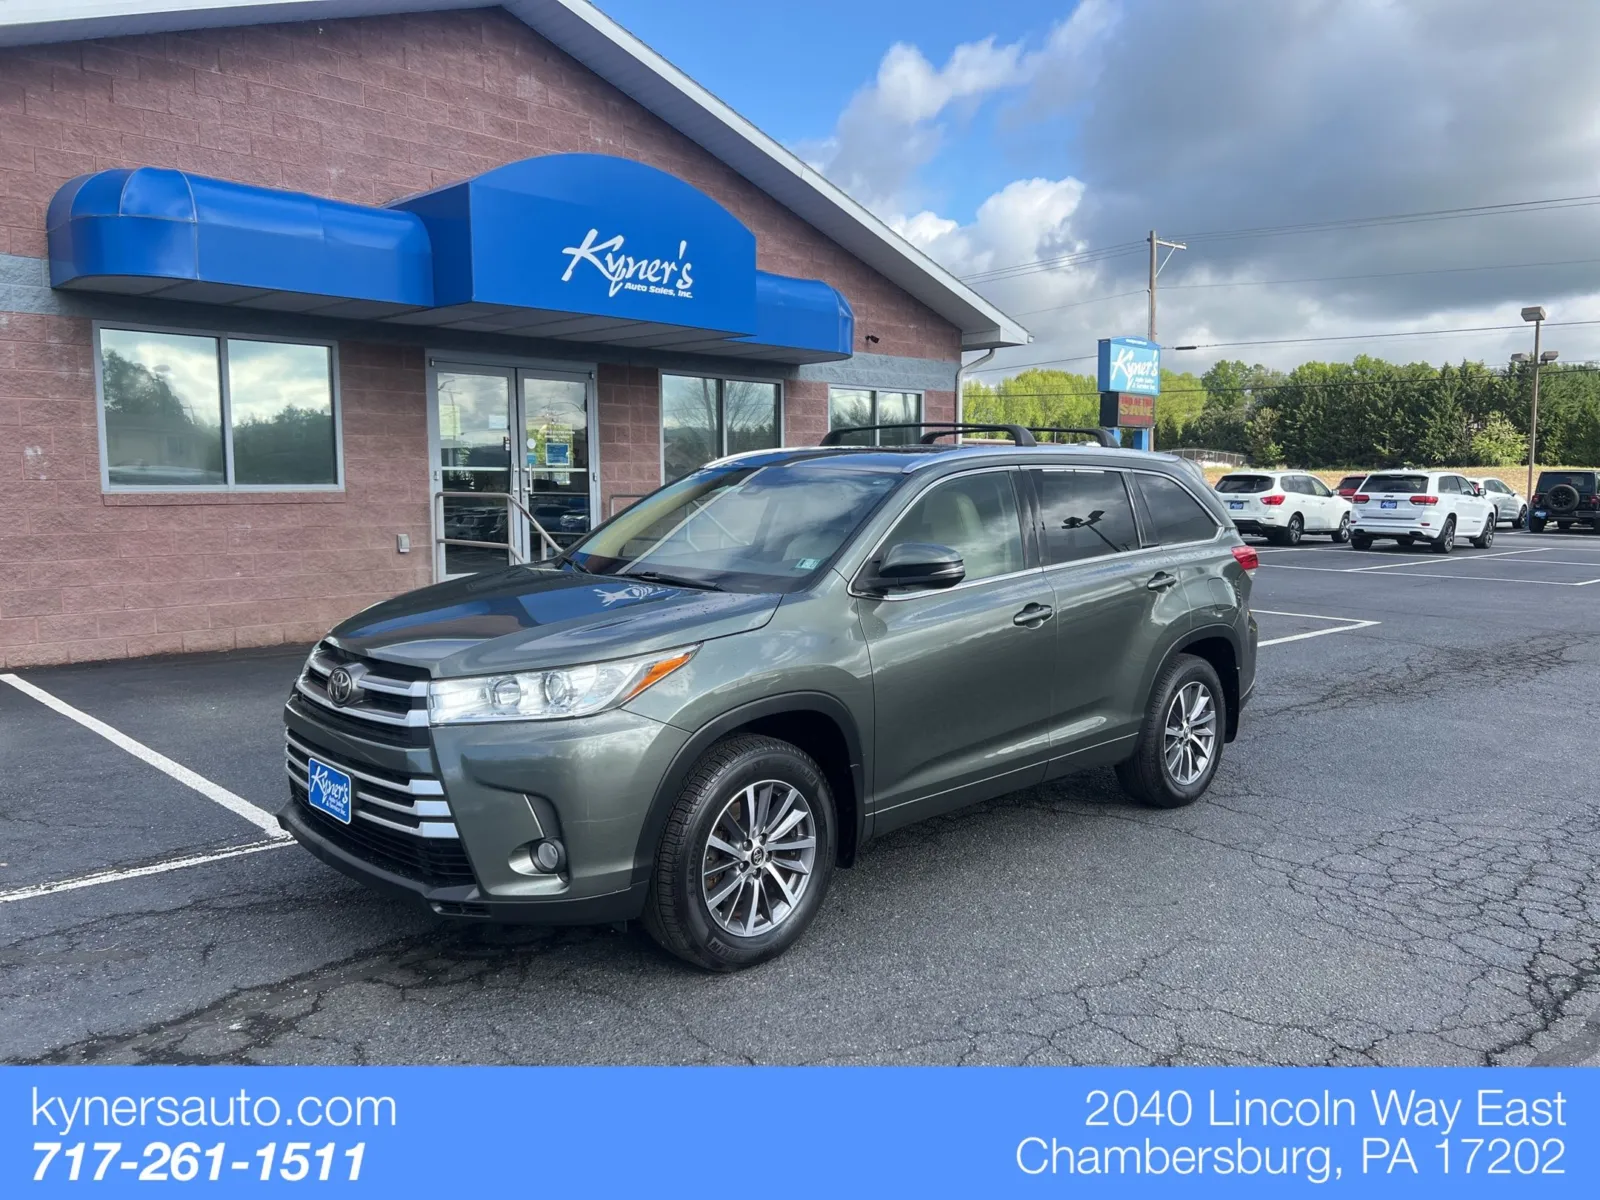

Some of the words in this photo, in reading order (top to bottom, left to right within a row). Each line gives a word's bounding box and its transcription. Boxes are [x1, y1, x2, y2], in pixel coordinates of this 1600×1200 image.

[561, 228, 693, 297] Kyner's
[624, 282, 648, 292] Auto
[677, 289, 694, 299] Inc.
[1111, 347, 1158, 391] Kyner's
[311, 765, 348, 804] Kyner's
